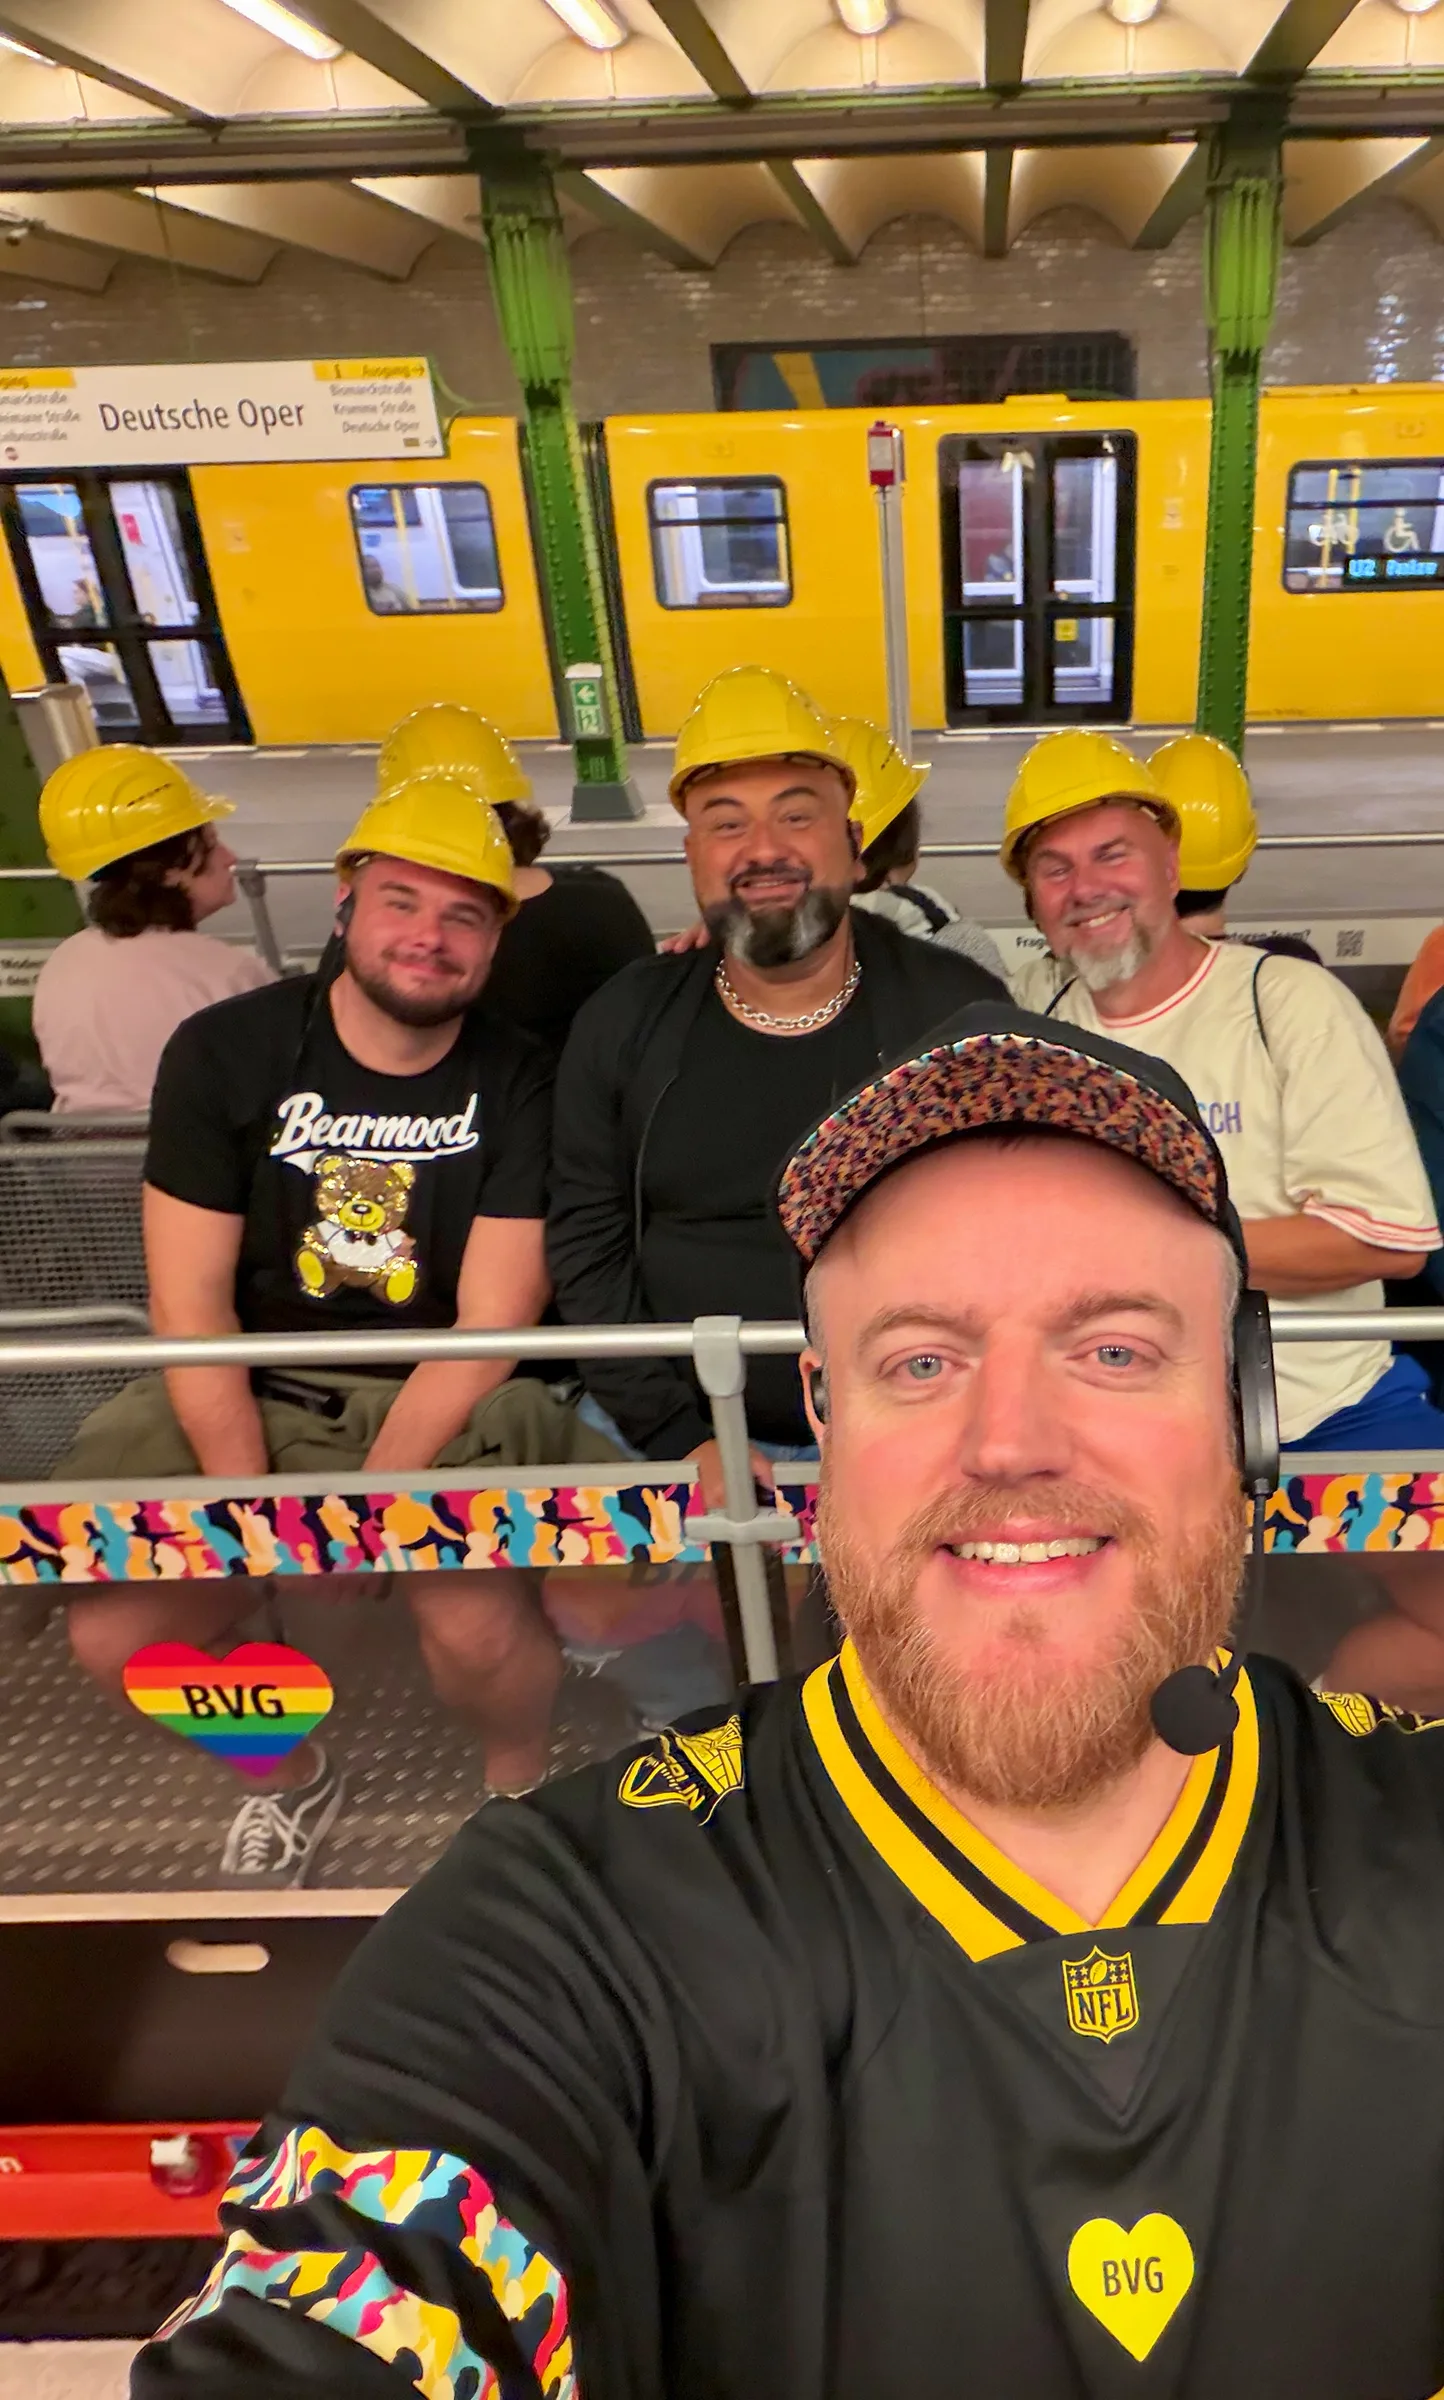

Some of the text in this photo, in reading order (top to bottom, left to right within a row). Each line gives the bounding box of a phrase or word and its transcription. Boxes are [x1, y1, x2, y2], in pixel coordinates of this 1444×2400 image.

[362, 364, 411, 379] Ausgang
[98, 398, 305, 436] Deutsche Oper
[342, 420, 420, 434] Deutsche Oper
[1349, 559, 1376, 577] U2
[1016, 936, 1046, 950] Frag
[269, 1091, 480, 1157] Bearmood
[181, 1684, 286, 1719] BVG
[1075, 1987, 1131, 2029] NFL
[1102, 2256, 1164, 2297] BVG
